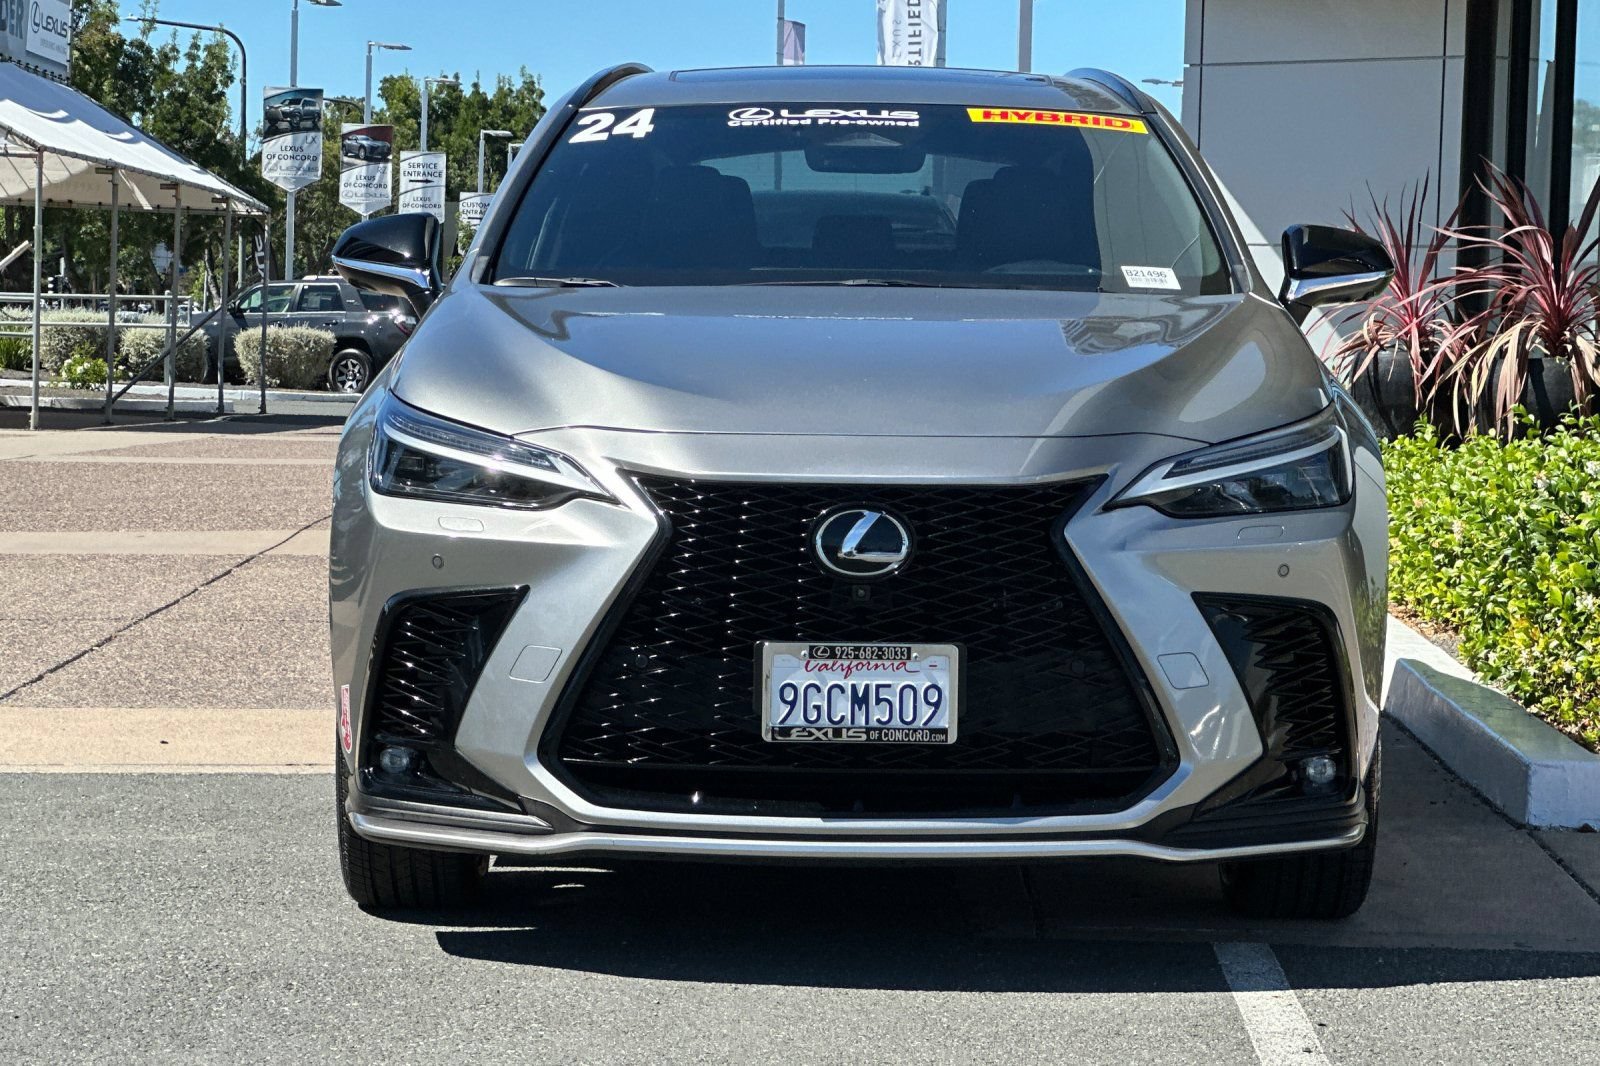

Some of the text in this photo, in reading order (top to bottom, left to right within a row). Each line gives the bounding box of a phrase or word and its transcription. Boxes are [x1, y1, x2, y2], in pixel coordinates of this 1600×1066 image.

[41, 13, 68, 38] LEXUS
[780, 109, 920, 119] LEXUS
[982, 110, 1133, 129] HYBRID
[568, 108, 655, 144] 24
[727, 119, 920, 127] Certified Pre-owned
[277, 153, 318, 161] CONCORD
[408, 162, 438, 170] SERVICE
[1125, 269, 1167, 279] B21496
[835, 646, 908, 660] 925-682-3033
[804, 659, 920, 679] California
[777, 682, 943, 726] 9GCM509
[774, 728, 867, 741] LEXUS
[869, 730, 879, 740] OF
